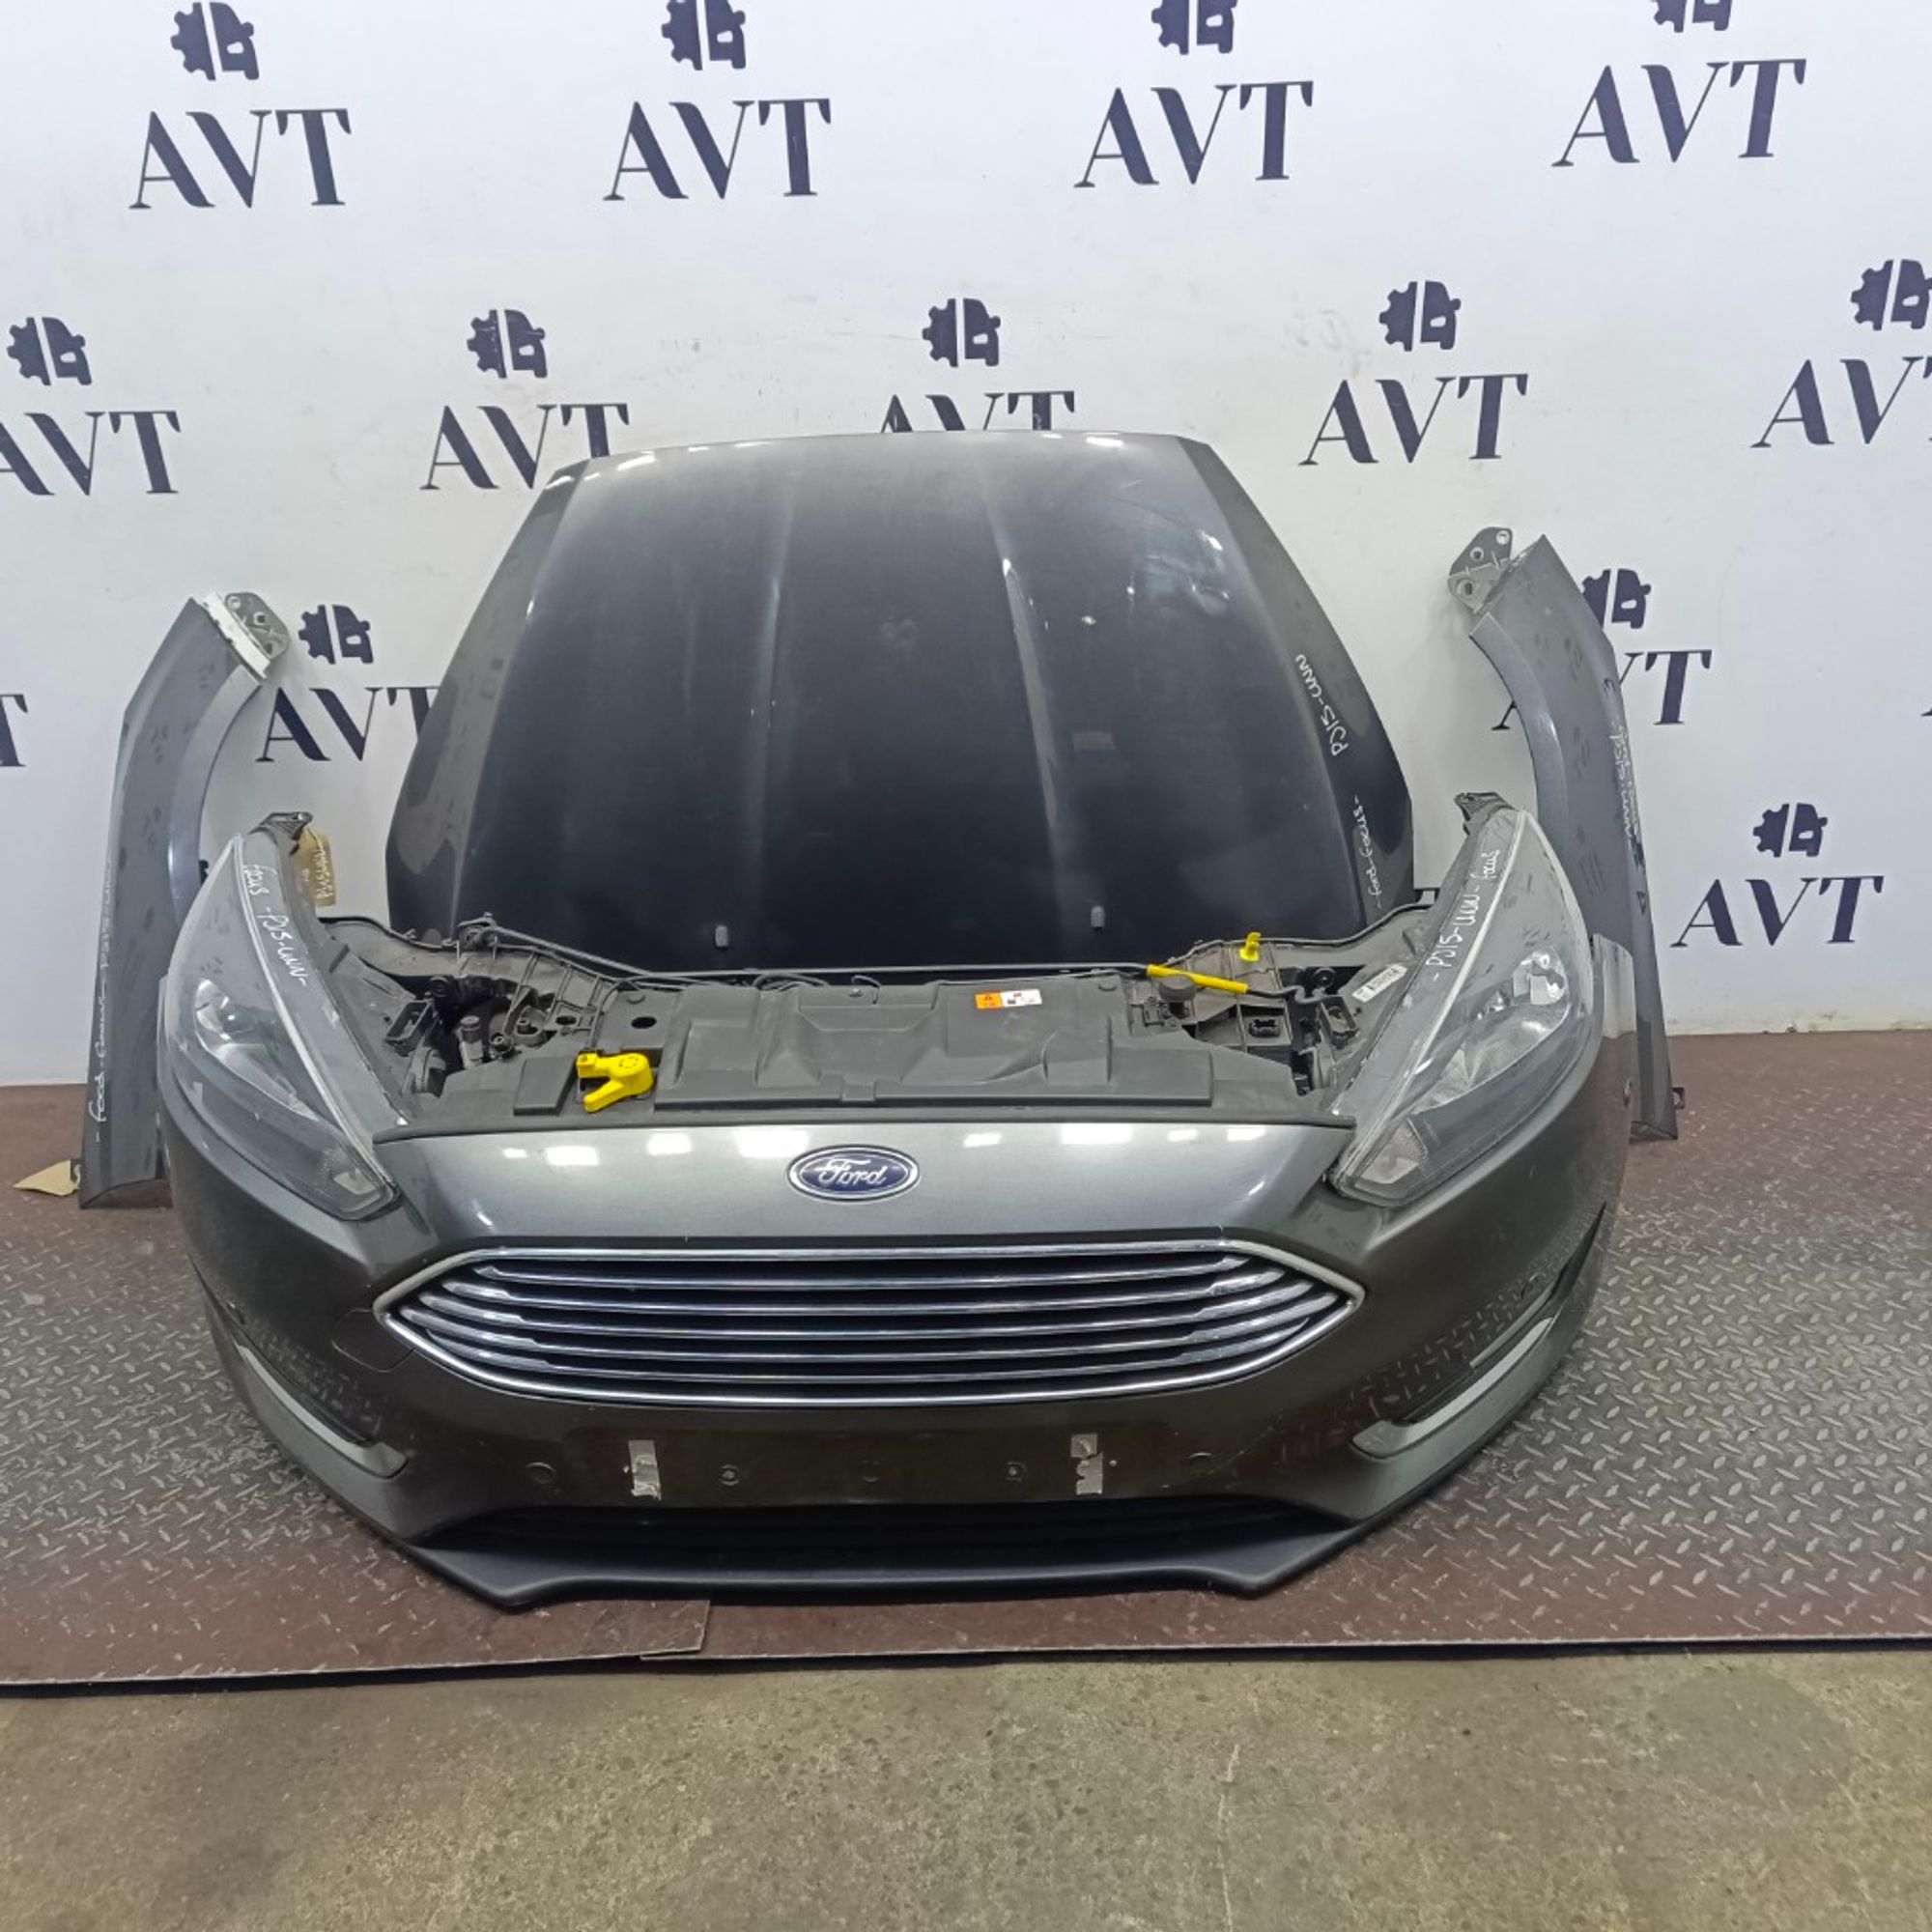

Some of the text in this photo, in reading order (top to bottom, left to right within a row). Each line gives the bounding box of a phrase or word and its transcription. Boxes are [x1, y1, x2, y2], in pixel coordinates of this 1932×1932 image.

[128, 108, 352, 209] AVT
[603, 99, 833, 201] AVT
[1073, 81, 1312, 187] AVT
[1551, 59, 1806, 167] AVT
[419, 403, 630, 490] AVT
[1299, 374, 1528, 466] AVT
[1750, 355, 1932, 448] AV
[1670, 875, 1884, 948] AVT
[814, 1157, 889, 1185] Ford
